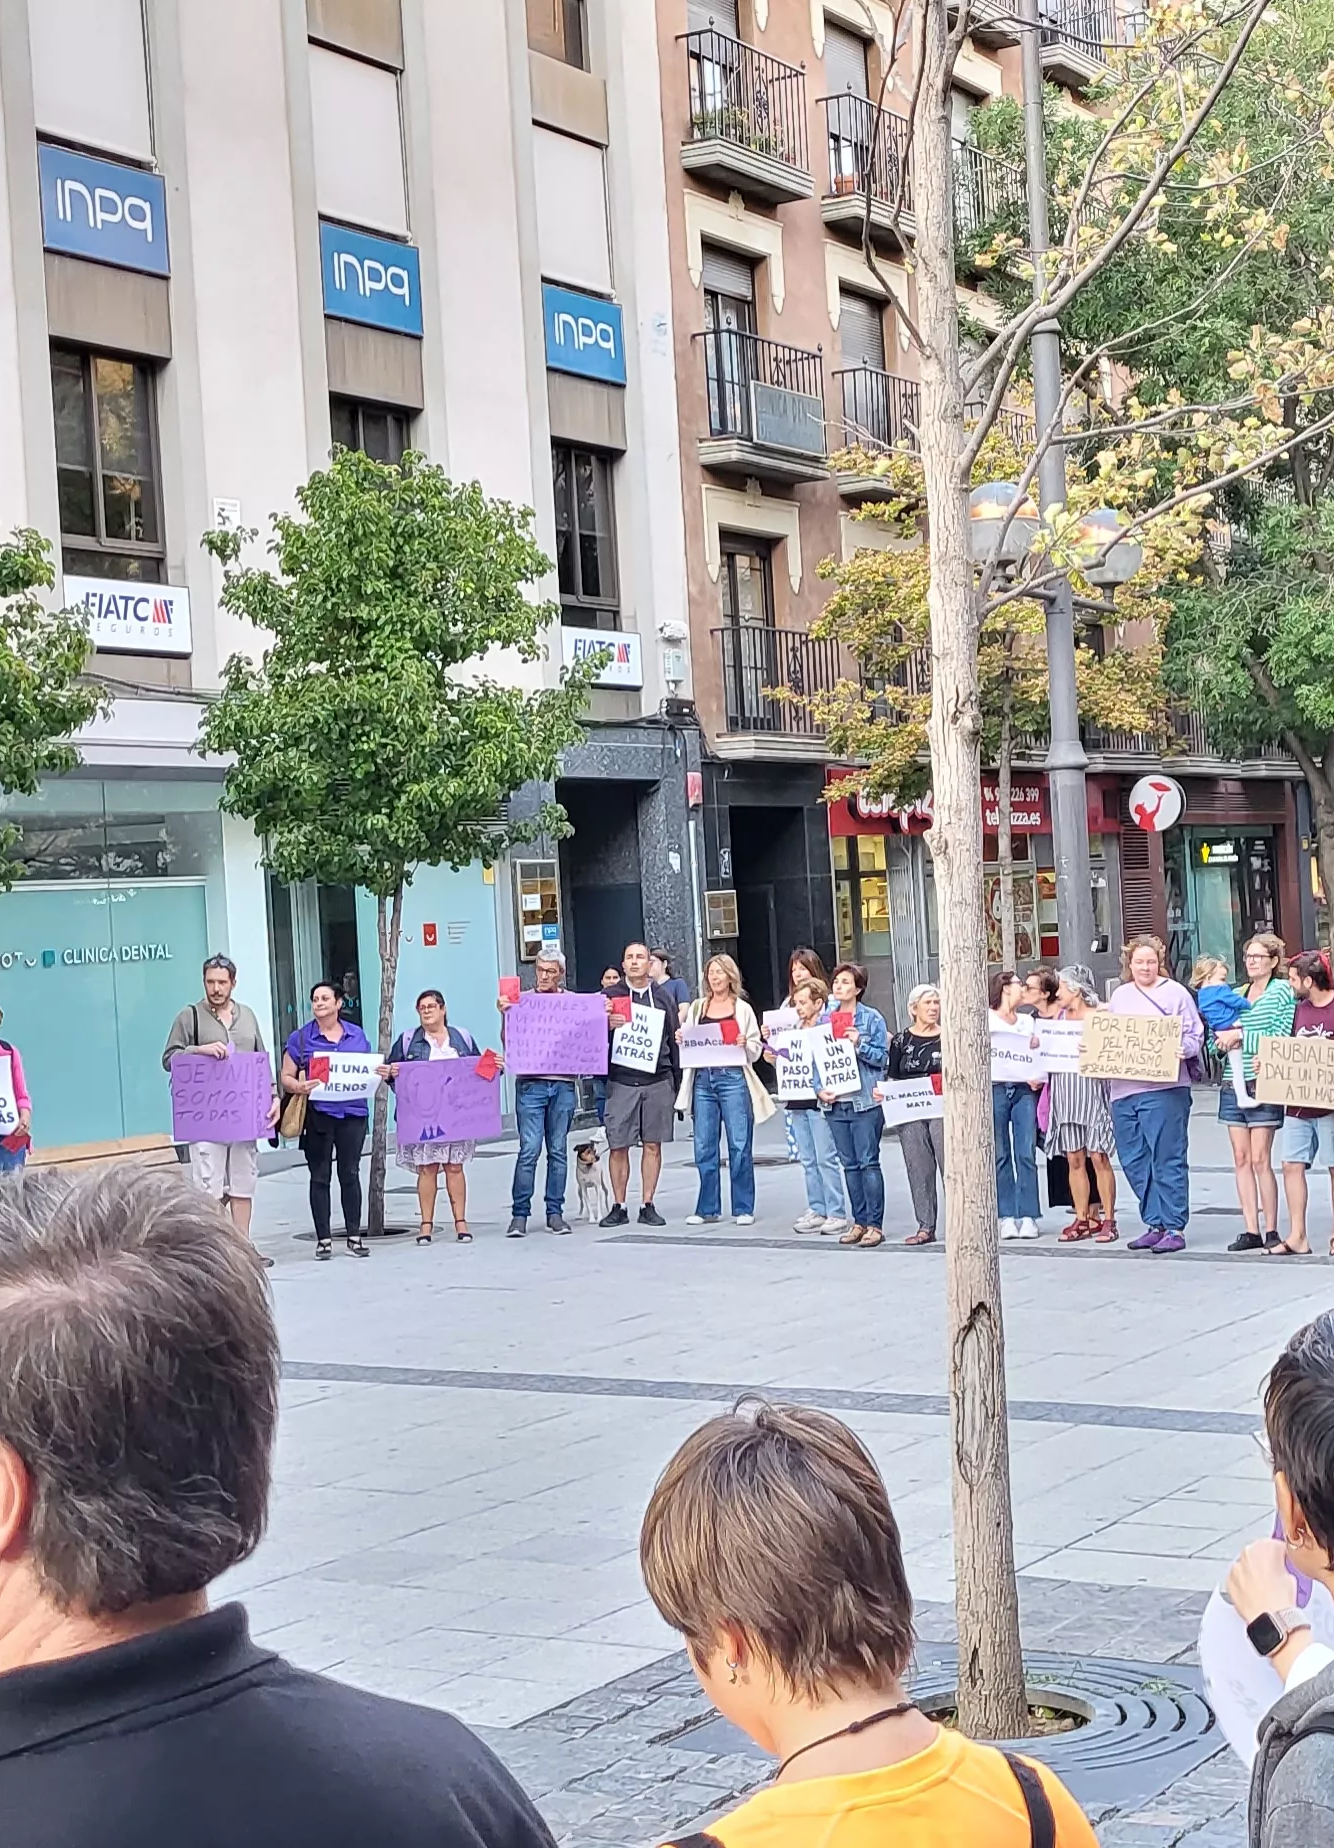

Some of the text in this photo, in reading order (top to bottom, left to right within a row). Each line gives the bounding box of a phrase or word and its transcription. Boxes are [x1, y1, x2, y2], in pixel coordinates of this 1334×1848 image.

[96, 622, 173, 637] EGUROS
[1025, 788, 1040, 803] 399
[986, 809, 1041, 826] telizza.es
[122, 943, 173, 961] DENTAL
[635, 1012, 647, 1023] NI
[1092, 1016, 1121, 1032] POR
[1127, 1018, 1139, 1034] EL
[630, 1022, 649, 1034] UN
[620, 1033, 653, 1048] PASO
[790, 1039, 802, 1050] NI
[1102, 1036, 1122, 1050] DEL
[615, 1046, 655, 1062] ATRÁS
[788, 1052, 803, 1063] UN
[826, 1044, 844, 1057] UN
[990, 1048, 1033, 1064] SeAcab
[823, 1058, 852, 1072] PASO
[1098, 1050, 1163, 1068] FEMINISMO
[175, 1061, 250, 1085] JENNI
[328, 1063, 369, 1075] NI UNA
[782, 1065, 810, 1076] PASO
[1265, 1062, 1293, 1081] DALE
[1298, 1067, 1312, 1081] UN
[781, 1075, 815, 1090] ATRÁS
[825, 1071, 857, 1087] ATRÁS
[323, 1081, 367, 1093] MENOS
[1286, 1085, 1294, 1100] A
[1297, 1085, 1311, 1100] TU
[175, 1089, 252, 1108] SOMOS
[885, 1090, 934, 1102] EL MACHIS
[906, 1100, 932, 1109] MATA
[175, 1109, 243, 1124] TODAS
